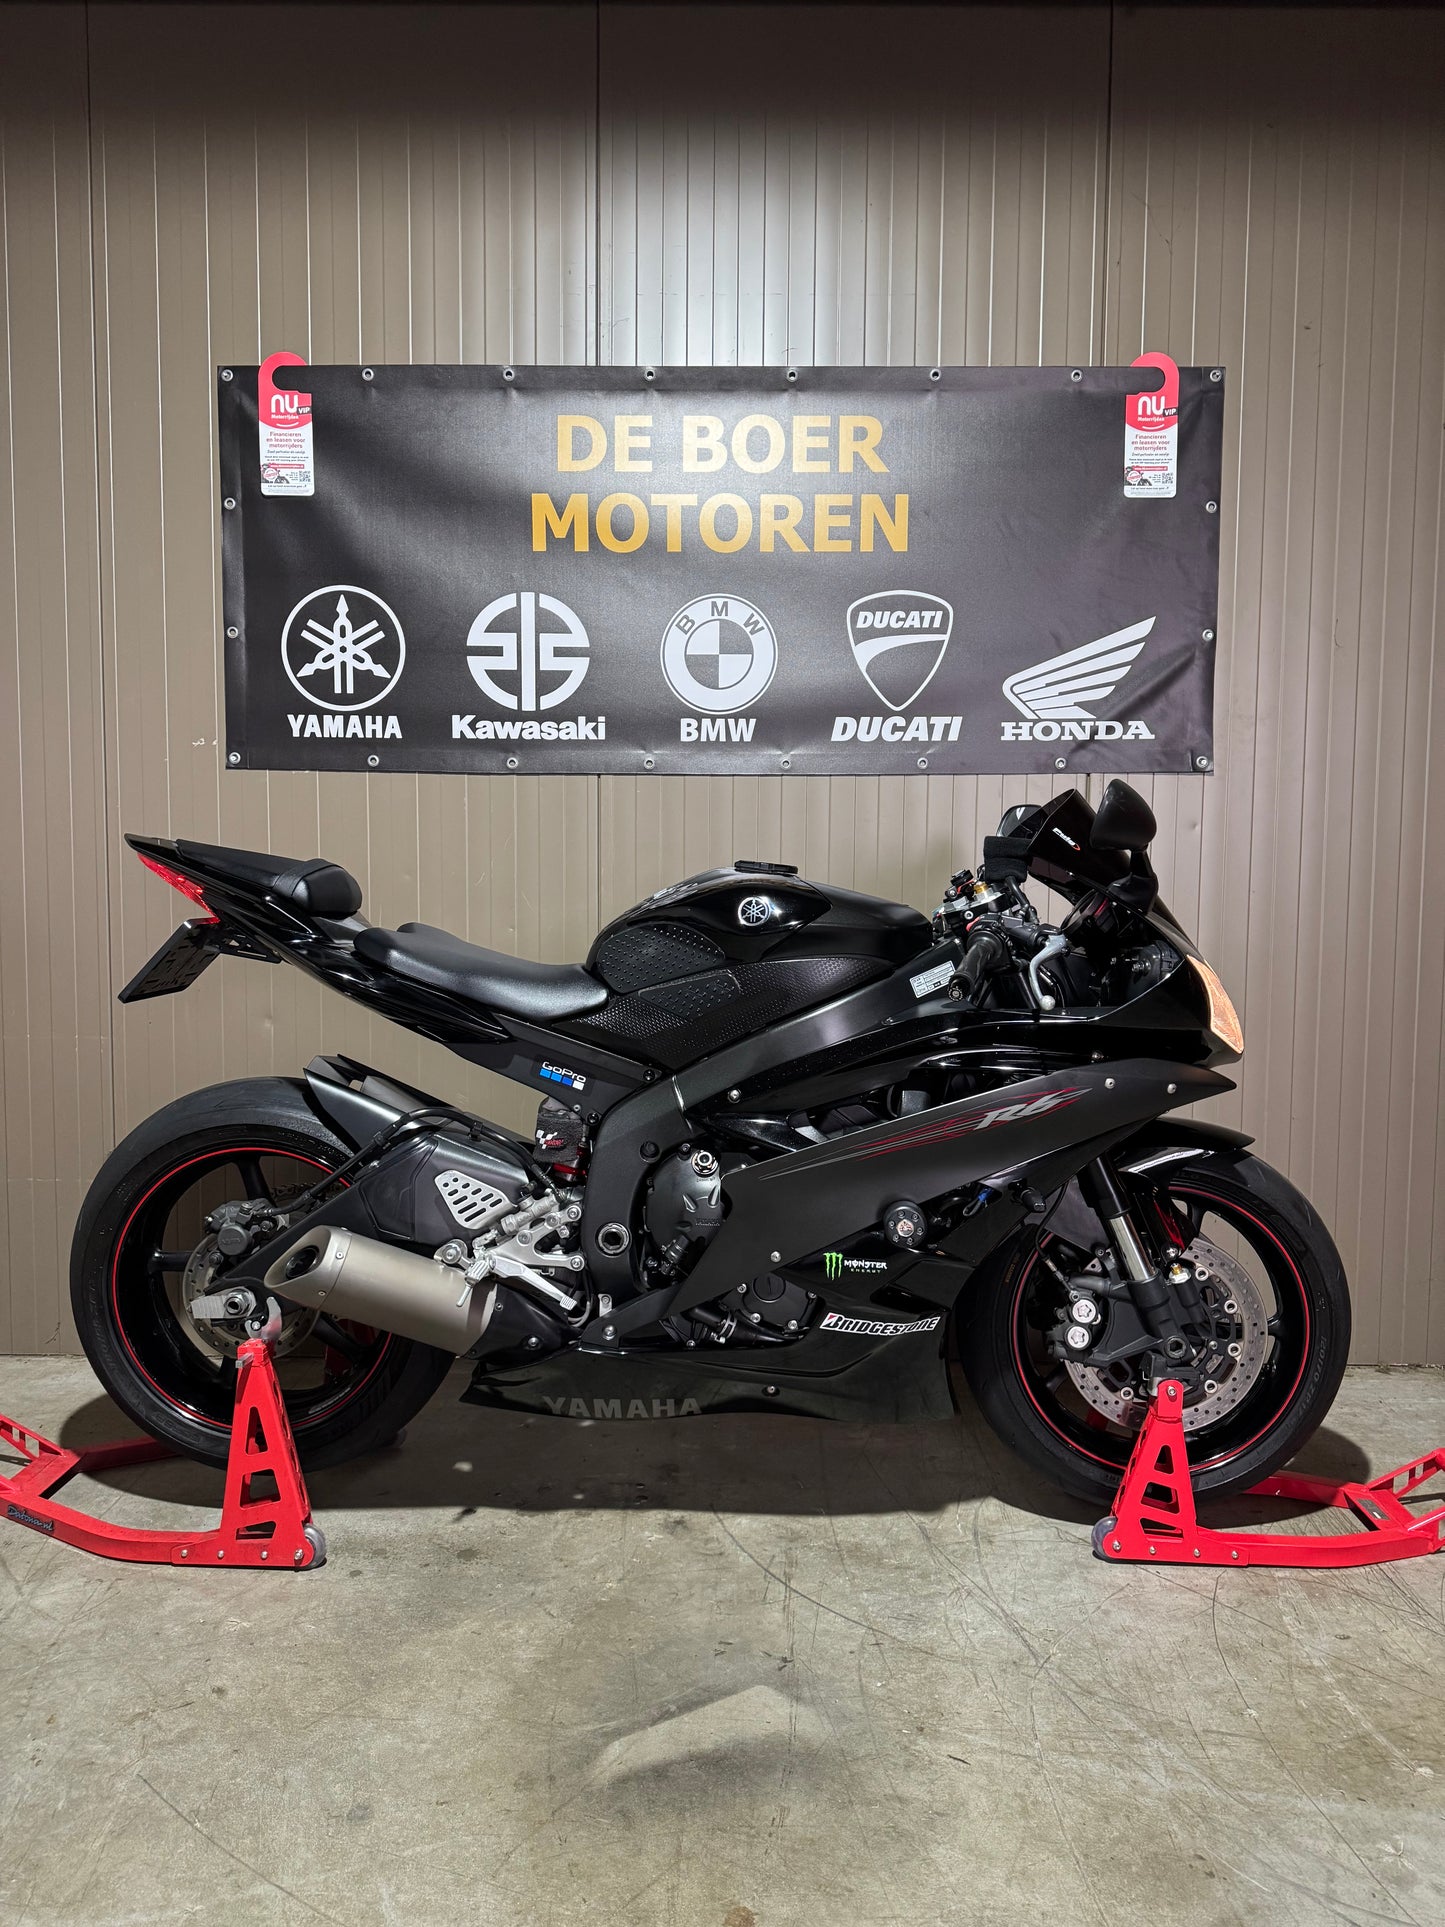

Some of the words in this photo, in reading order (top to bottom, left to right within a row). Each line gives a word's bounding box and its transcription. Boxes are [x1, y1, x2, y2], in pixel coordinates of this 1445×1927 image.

[1164, 408, 1176, 416] VIP
[557, 415, 653, 473] DE
[684, 415, 888, 474] BOER
[532, 492, 909, 554] MOTOREN
[675, 600, 765, 636] BMW
[856, 610, 944, 629] DUCATI
[287, 715, 403, 739] YAMAHA
[451, 715, 606, 741] Kawasaki
[680, 718, 757, 742] BMW
[831, 716, 963, 742] DUCATI
[1000, 720, 1156, 741] HONDA
[542, 1061, 586, 1083] GoPro
[973, 1088, 1081, 1131] R6
[822, 1314, 940, 1335] BRIDGESTONE
[542, 1396, 702, 1419] YAMAHA
